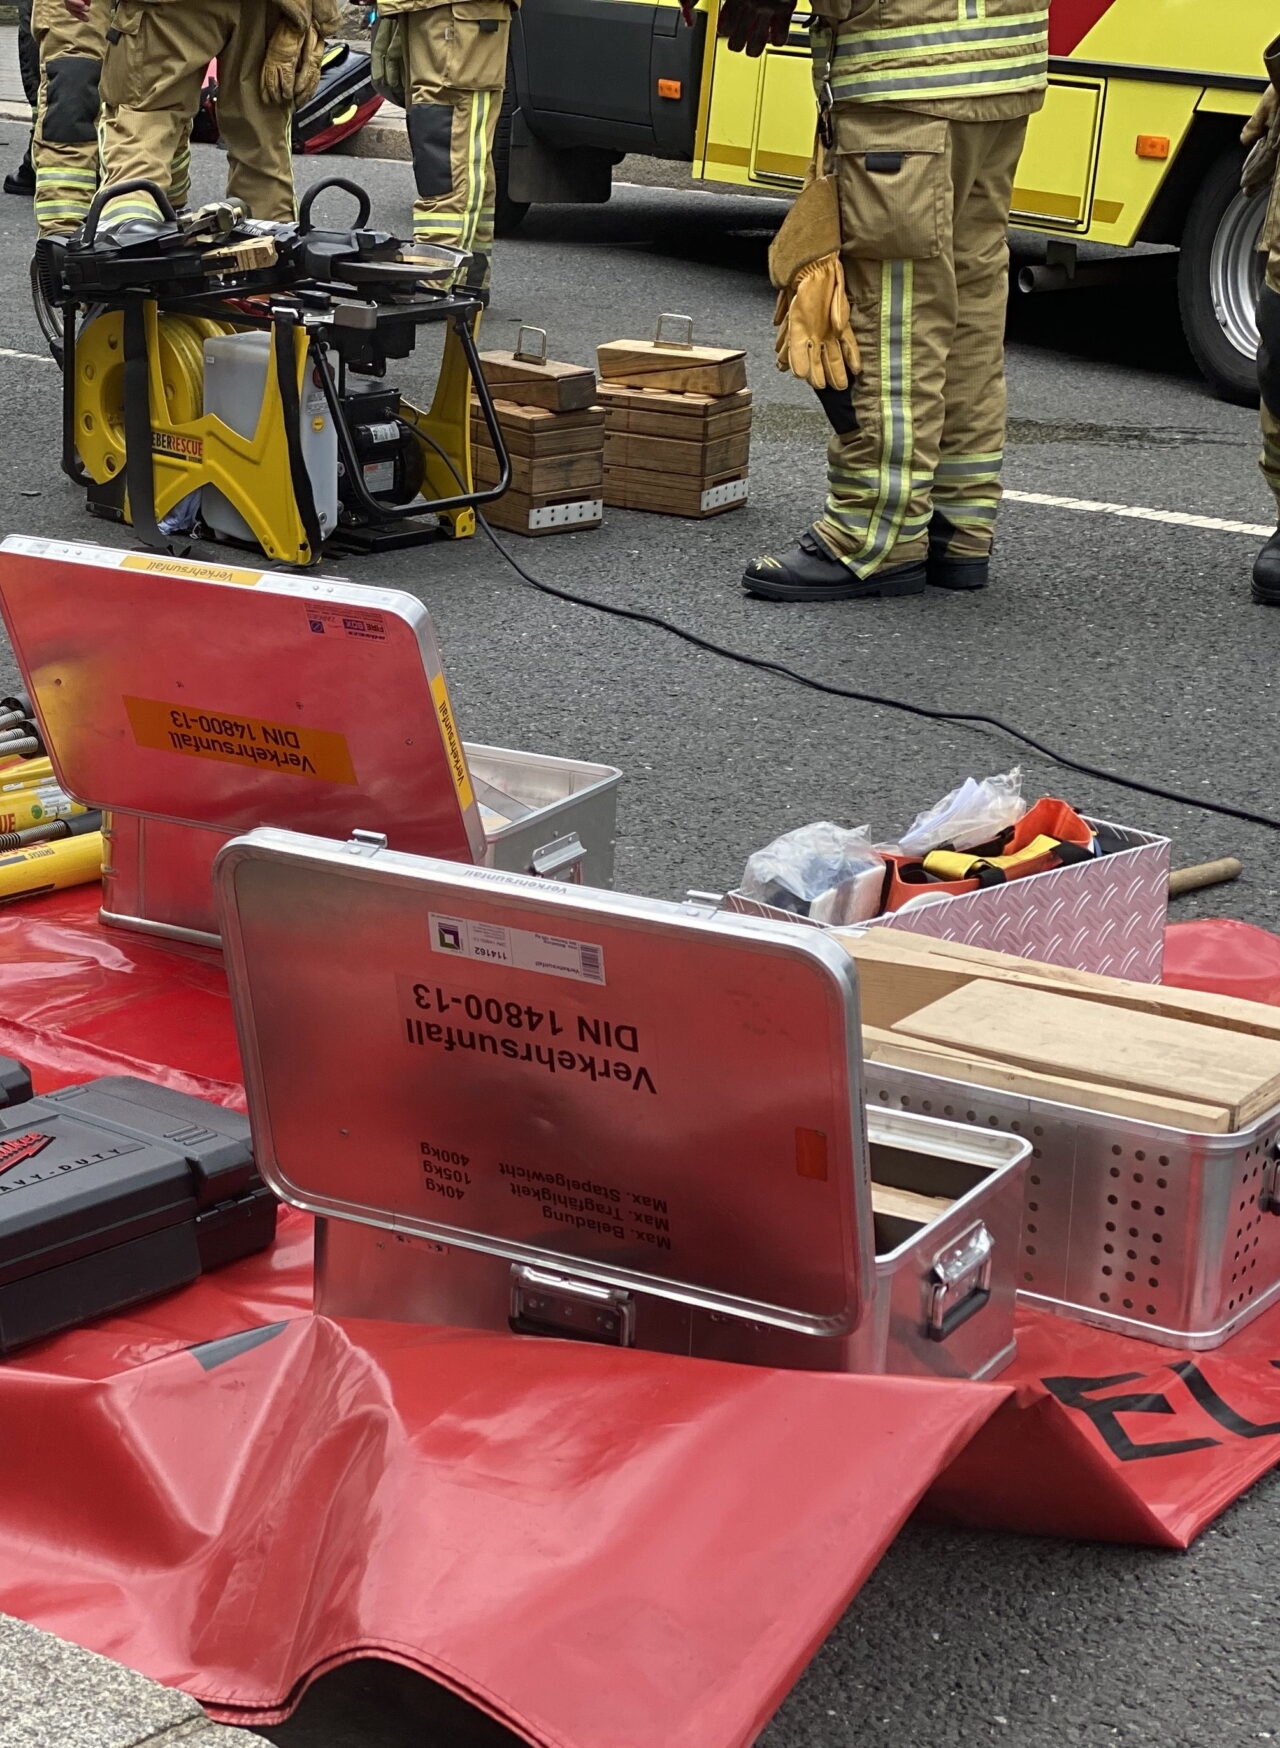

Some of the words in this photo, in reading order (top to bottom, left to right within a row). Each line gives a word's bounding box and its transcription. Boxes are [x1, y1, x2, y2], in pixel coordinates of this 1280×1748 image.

[151, 431, 204, 458] EBERRESCUE
[146, 561, 233, 582] Verkehrsunfall
[170, 711, 256, 741] 14800-13
[262, 726, 300, 749] DIN
[168, 731, 316, 774] Verkehrsunfall
[439, 700, 465, 786] Verkehrsunfall
[464, 869, 568, 895] Verkehrsunfall
[474, 946, 508, 960] 114162
[413, 984, 564, 1036] 14800-13
[577, 1016, 640, 1053] DIN
[406, 1018, 658, 1095] Verkehrsunfall
[420, 1141, 470, 1168] 400kg
[423, 1160, 472, 1186] 105kg
[498, 1162, 621, 1202] Stapelgewicht
[425, 1177, 465, 1201] 40kg
[510, 1182, 624, 1222] Tragfähigkeit
[625, 1192, 668, 1214] Max.
[542, 1205, 625, 1240] Beladung
[627, 1211, 670, 1232] Max.
[629, 1230, 671, 1250] Max.
[1040, 1359, 1280, 1462] EL
